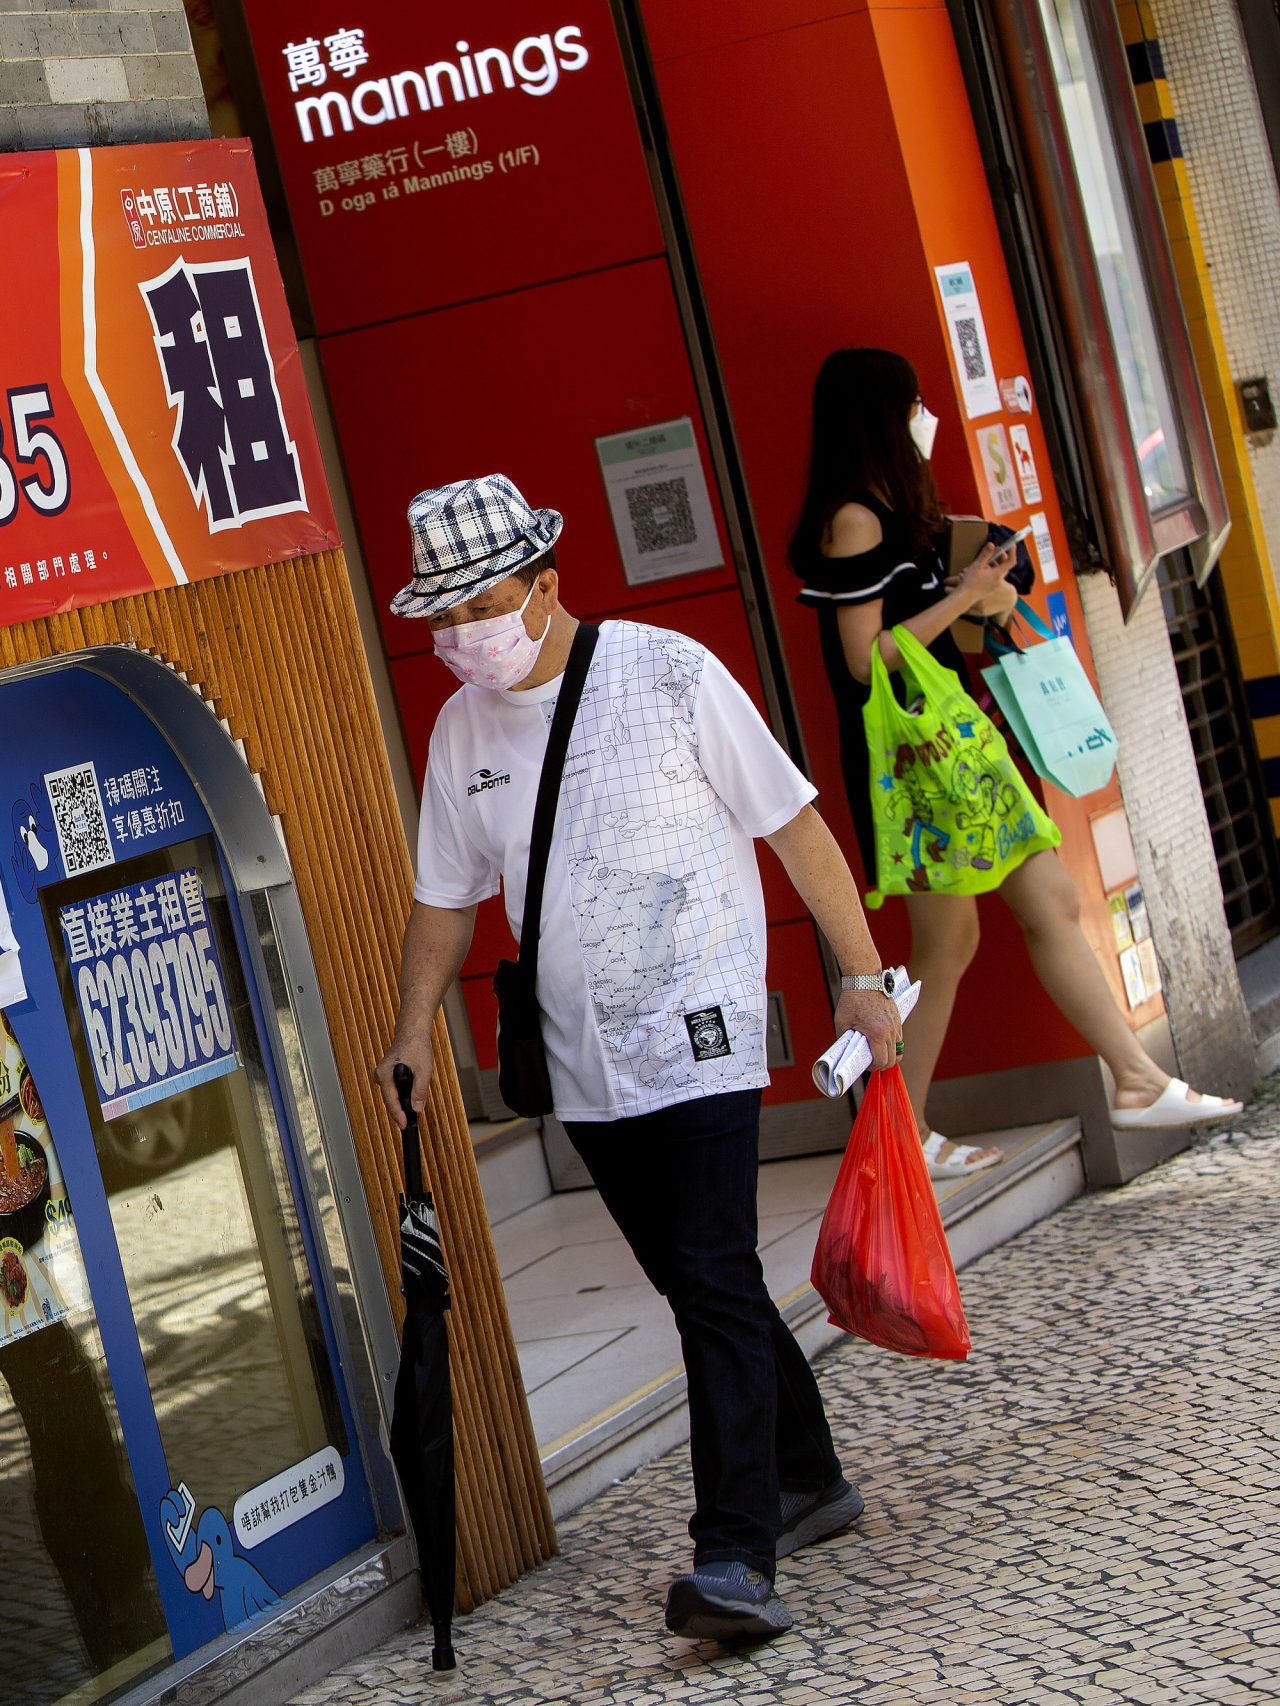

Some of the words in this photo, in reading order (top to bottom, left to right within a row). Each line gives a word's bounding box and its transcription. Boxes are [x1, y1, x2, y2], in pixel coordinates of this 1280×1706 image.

[282, 28, 369, 92] 萬寧
[295, 25, 589, 143] mannings
[403, 159, 494, 195] Mannings
[498, 144, 540, 173] (1/F)
[146, 226, 192, 246] CENTALINE
[191, 222, 246, 241] COMMERCIAL
[137, 256, 310, 536] 租
[104, 765, 163, 807] 掃碼關注
[112, 798, 185, 844] 享優惠折扣
[61, 871, 207, 964] 直接業主租售
[78, 927, 232, 1096] 62393795
